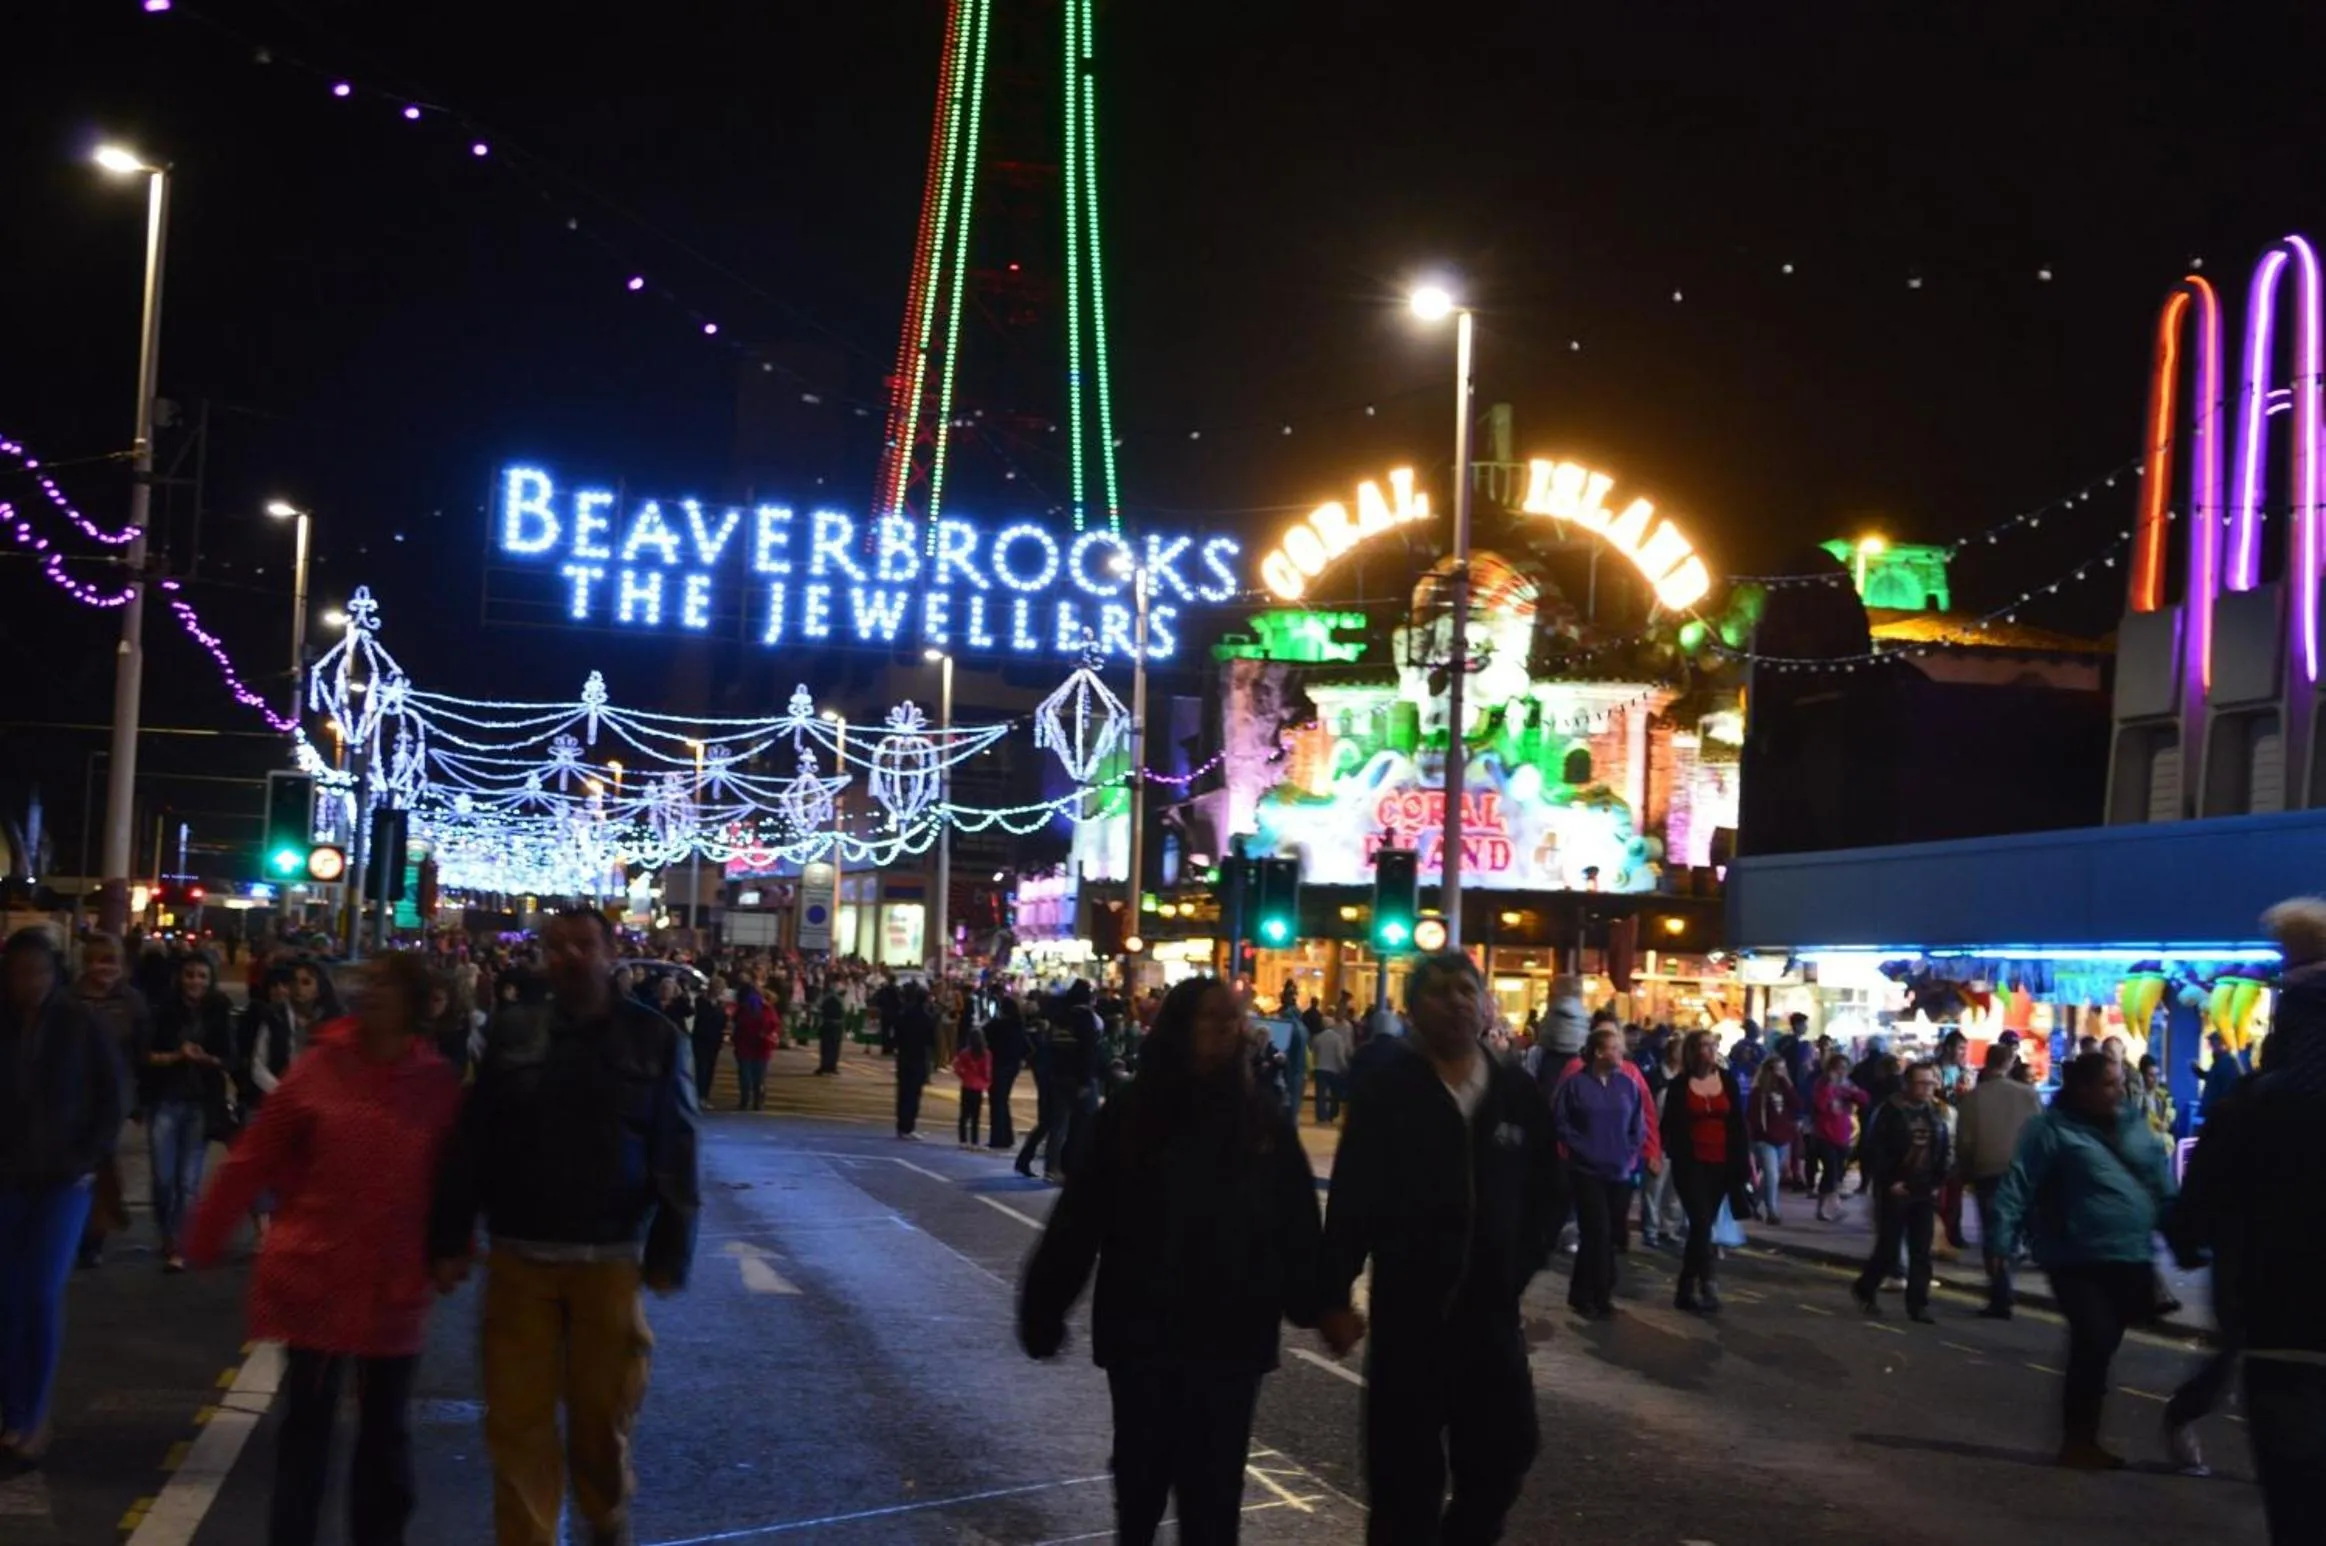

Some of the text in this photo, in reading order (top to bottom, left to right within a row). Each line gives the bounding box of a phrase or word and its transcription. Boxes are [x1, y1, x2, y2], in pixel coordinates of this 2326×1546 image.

[1261, 459, 1710, 611] CORAL ISLAND
[563, 564, 1178, 660] THE JEWELLERS
